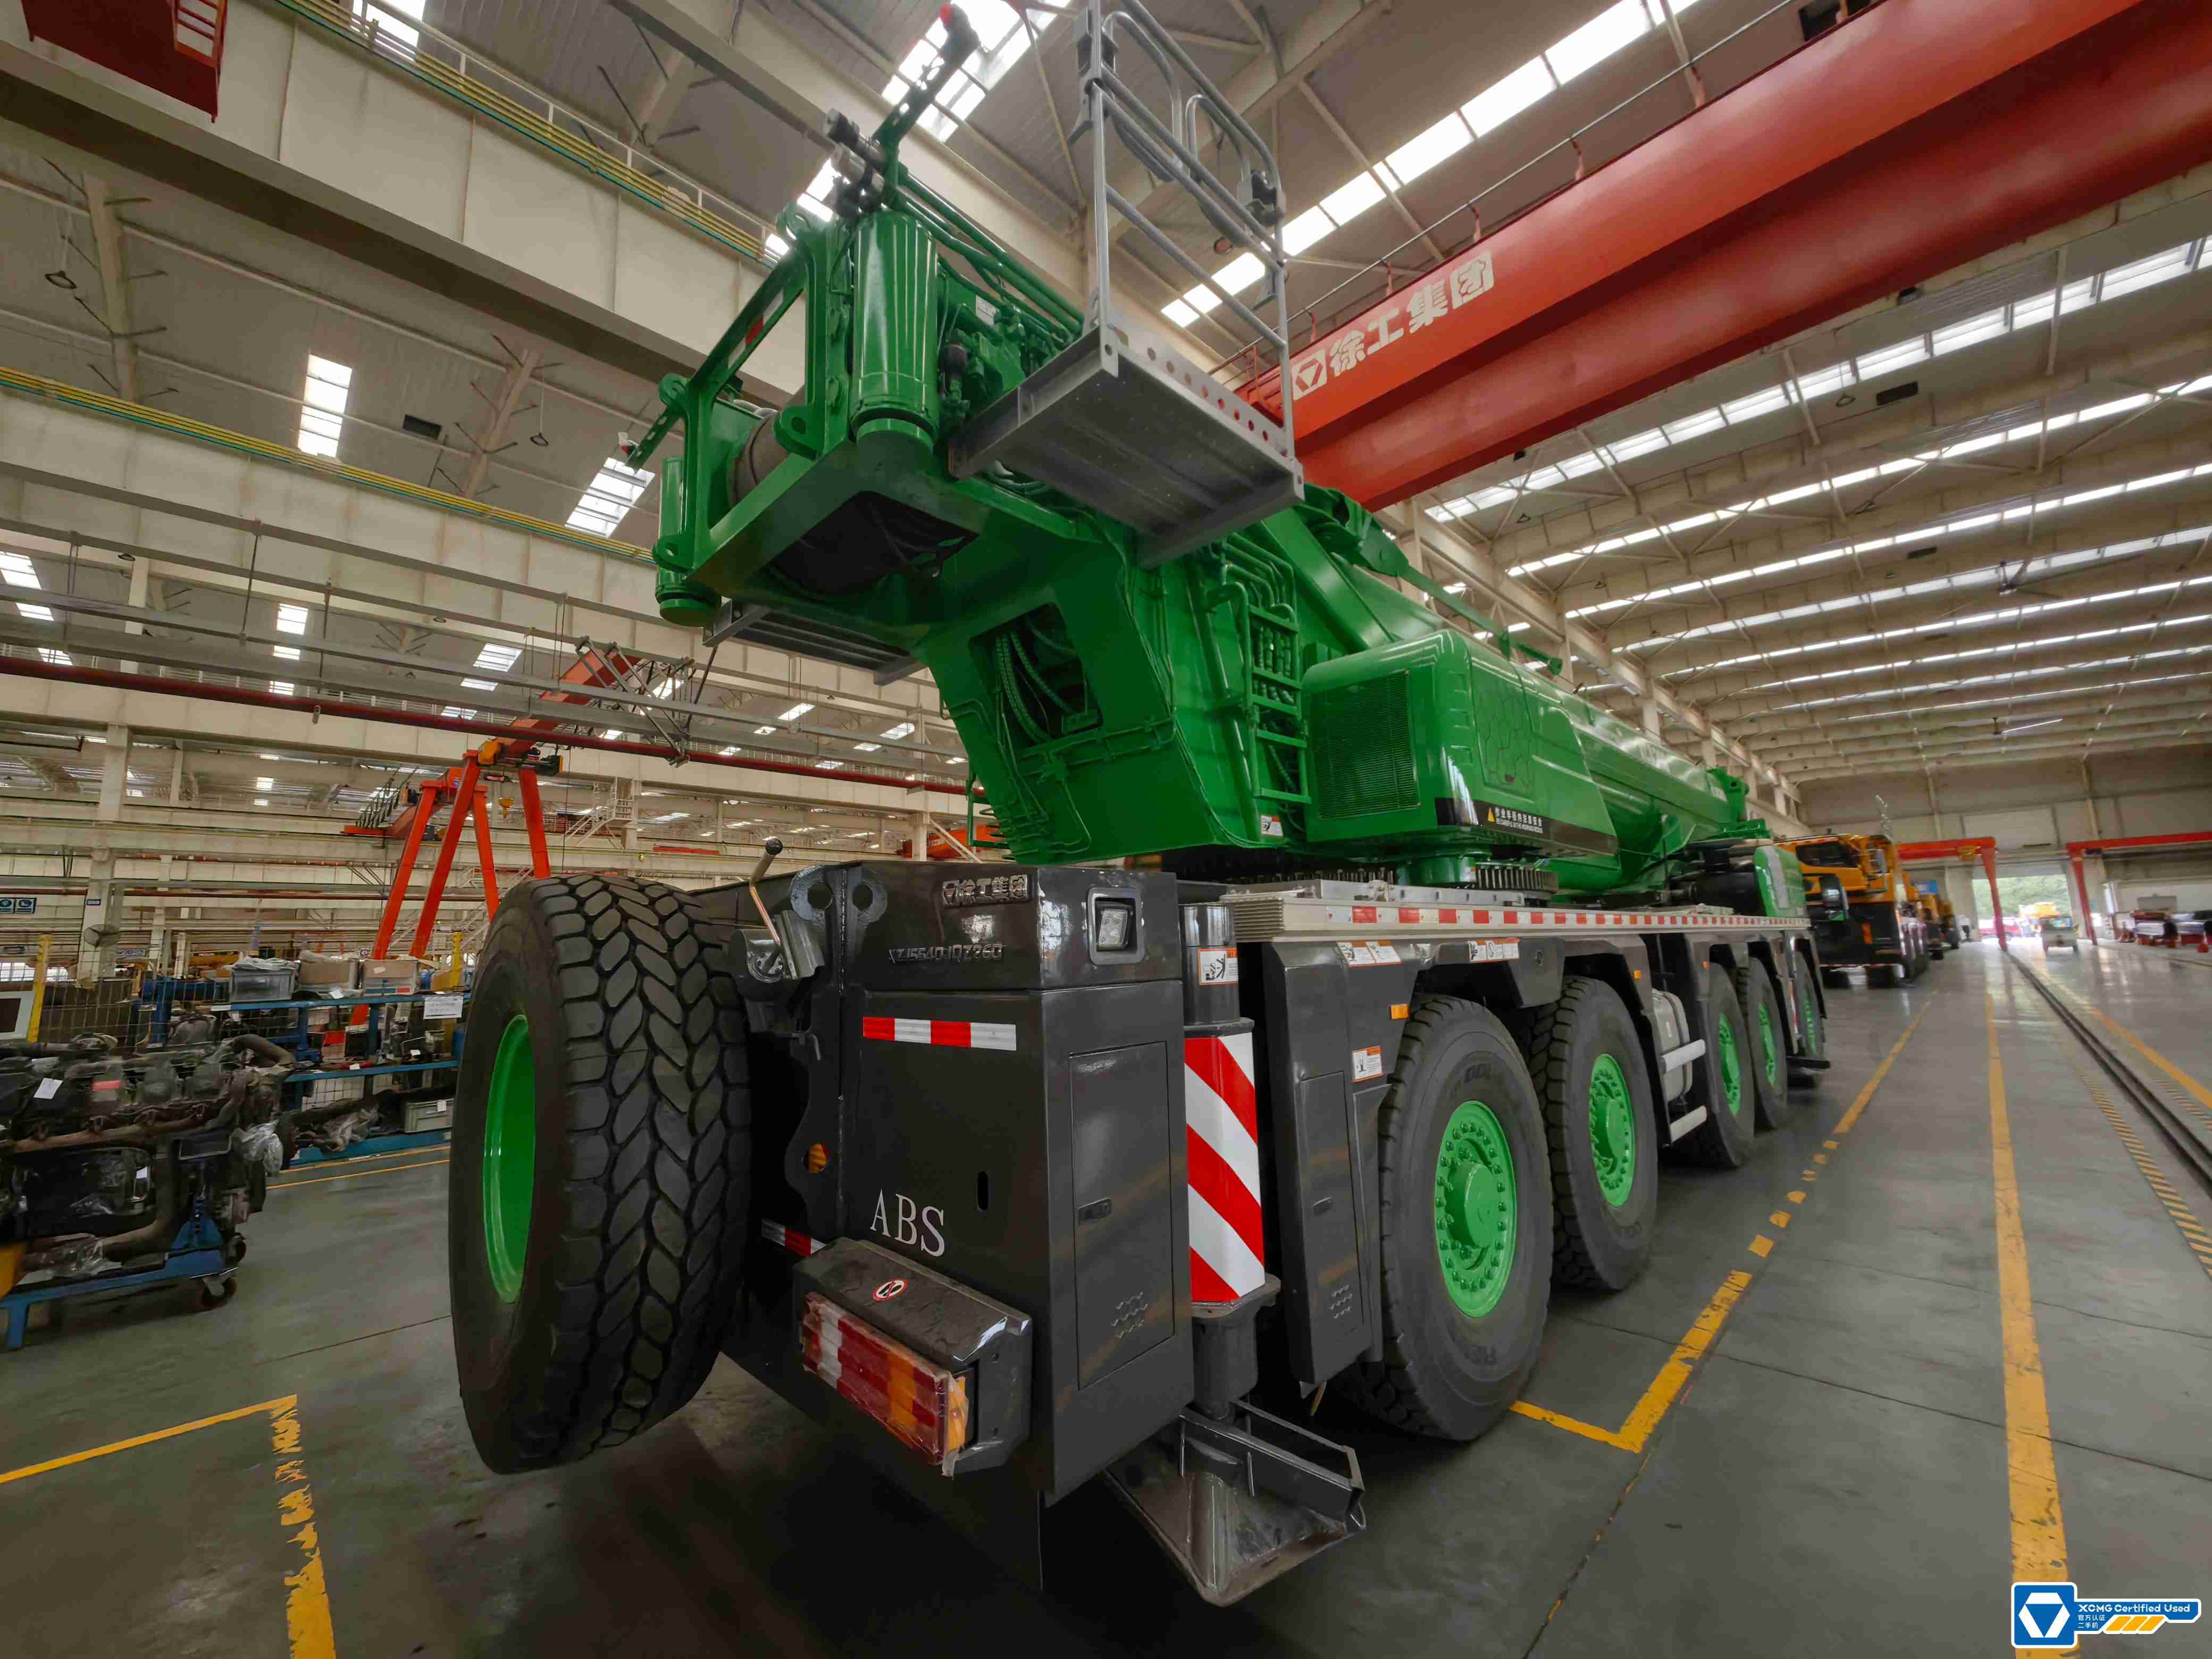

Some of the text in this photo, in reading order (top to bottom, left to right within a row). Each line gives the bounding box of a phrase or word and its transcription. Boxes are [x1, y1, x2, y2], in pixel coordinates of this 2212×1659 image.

[1330, 251, 1494, 378] 徐工集团
[961, 874, 1028, 903] 徐工集团
[870, 1189, 945, 1256] ABS
